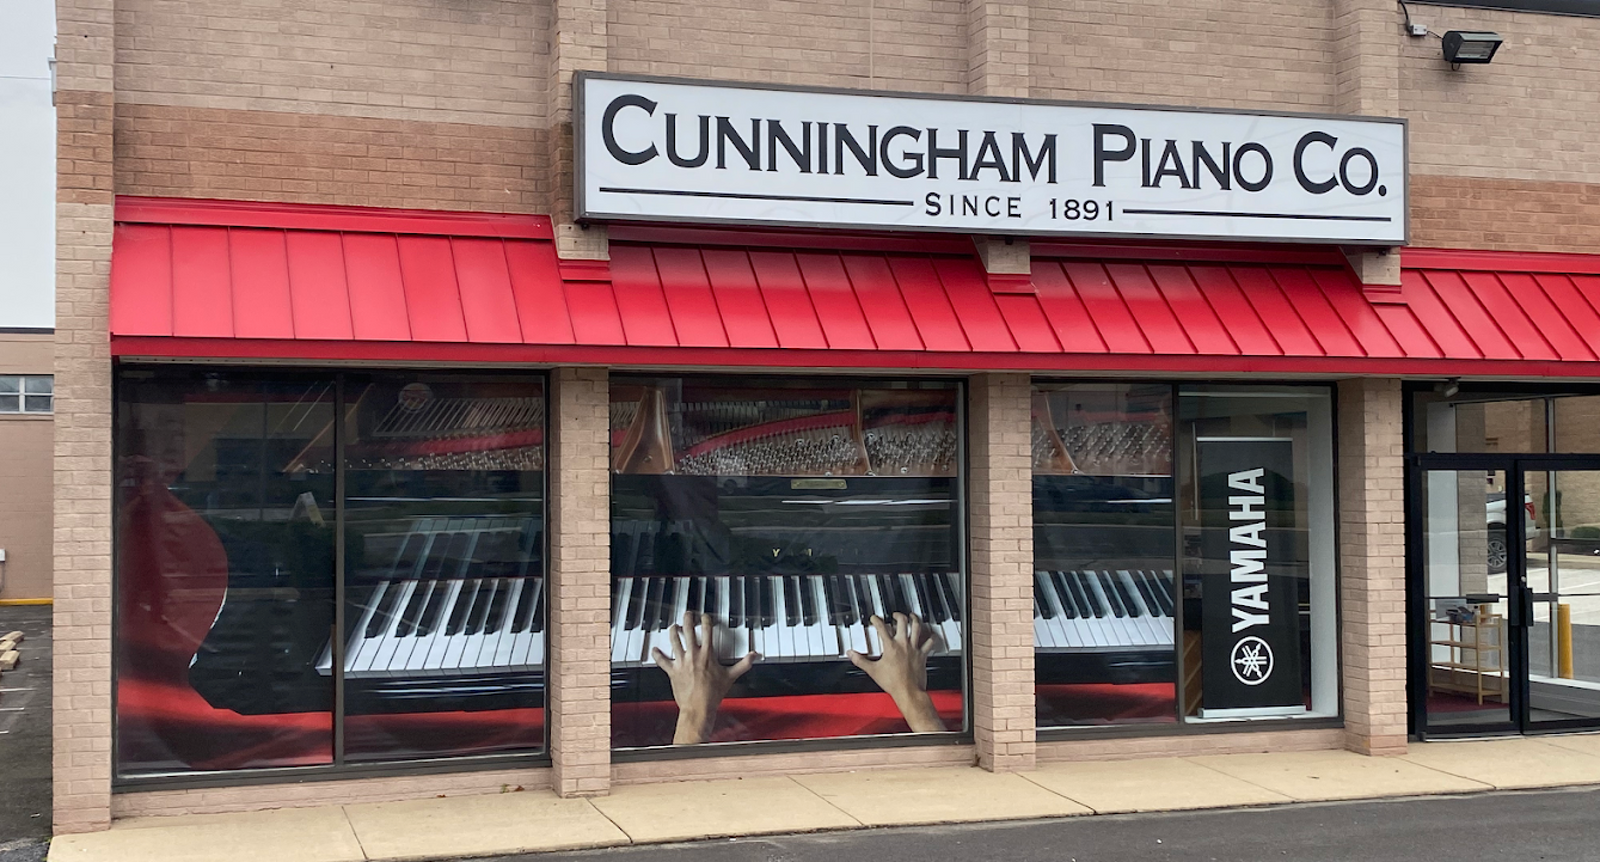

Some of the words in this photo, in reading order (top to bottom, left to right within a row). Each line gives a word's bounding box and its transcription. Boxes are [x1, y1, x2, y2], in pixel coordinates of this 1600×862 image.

[601, 94, 1058, 185] CUNNINGHAM
[1091, 123, 1274, 193] PIANO
[1293, 130, 1387, 197] CO.
[925, 191, 1022, 219] SINCE
[1049, 198, 1113, 221] 1891
[1228, 467, 1270, 633] YAMAHA
